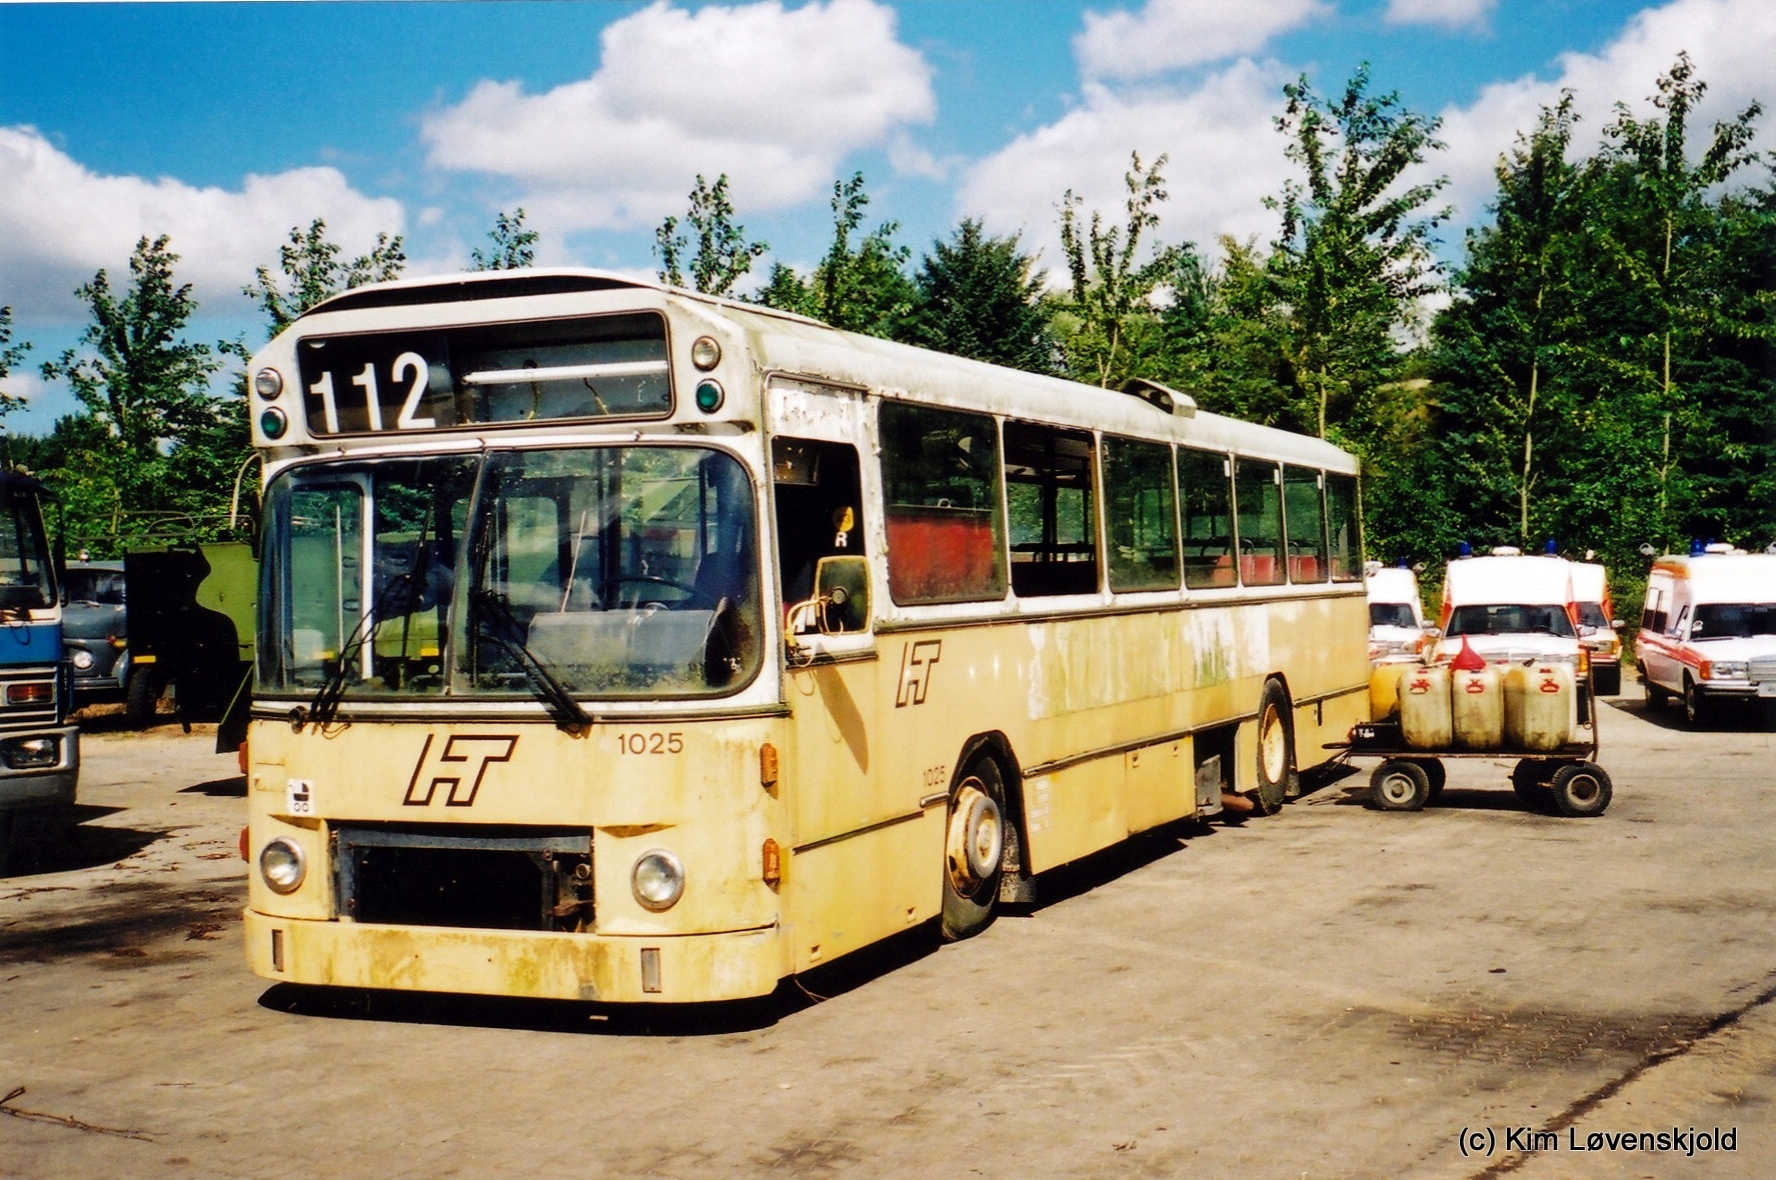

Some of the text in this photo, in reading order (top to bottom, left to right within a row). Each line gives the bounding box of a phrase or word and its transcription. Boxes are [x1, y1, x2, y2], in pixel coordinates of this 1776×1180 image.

[309, 352, 435, 434] 112
[895, 639, 942, 708] HT
[403, 734, 519, 807] HT
[618, 732, 684, 755] 1025
[923, 765, 945, 788] 1025
